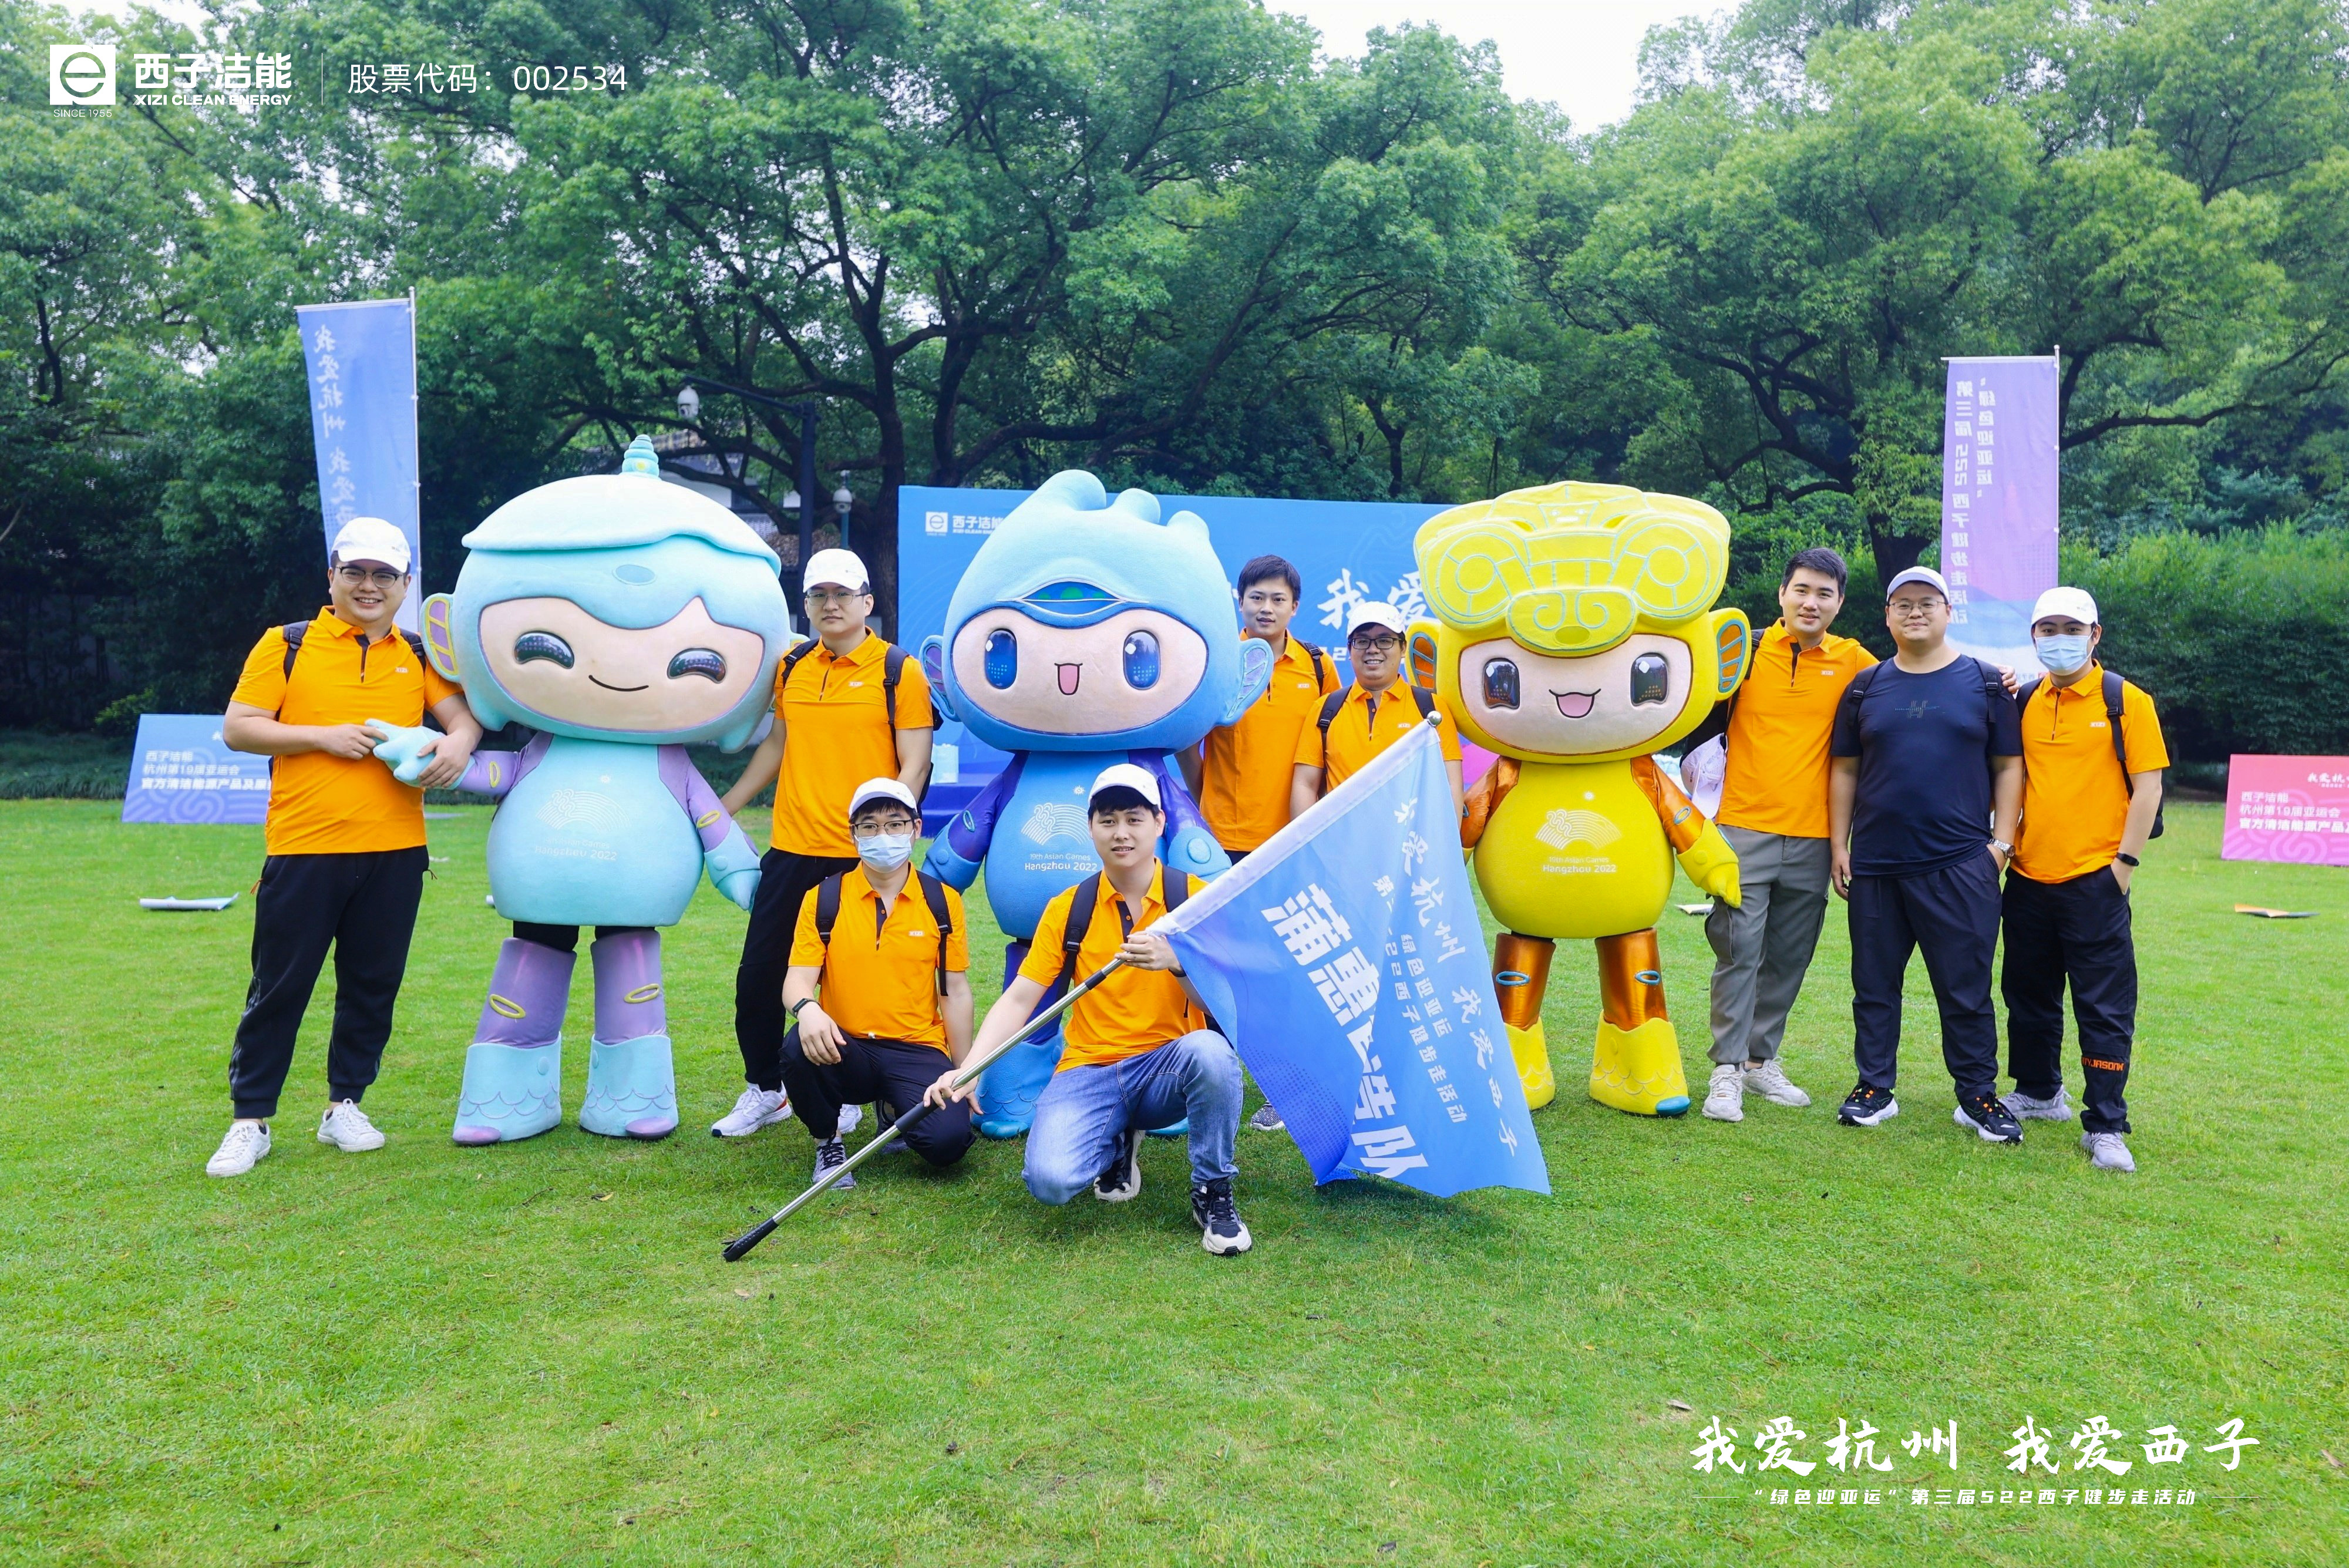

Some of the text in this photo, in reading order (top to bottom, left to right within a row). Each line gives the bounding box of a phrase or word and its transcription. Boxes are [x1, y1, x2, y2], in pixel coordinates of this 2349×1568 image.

[146, 751, 194, 762] 西子洁能
[143, 765, 240, 776] 杭州第19届亚运会
[2307, 772, 2349, 783] 我爱杭
[142, 778, 271, 790] 官方清洁能源产品及服
[2242, 792, 2289, 803] 西子洁能
[2239, 805, 2341, 818] 杭州第19届亚运会
[590, 849, 617, 861] 2022
[1025, 862, 1098, 872] Hangzhou 2022
[1542, 864, 1617, 874] Hangzhou 2022
